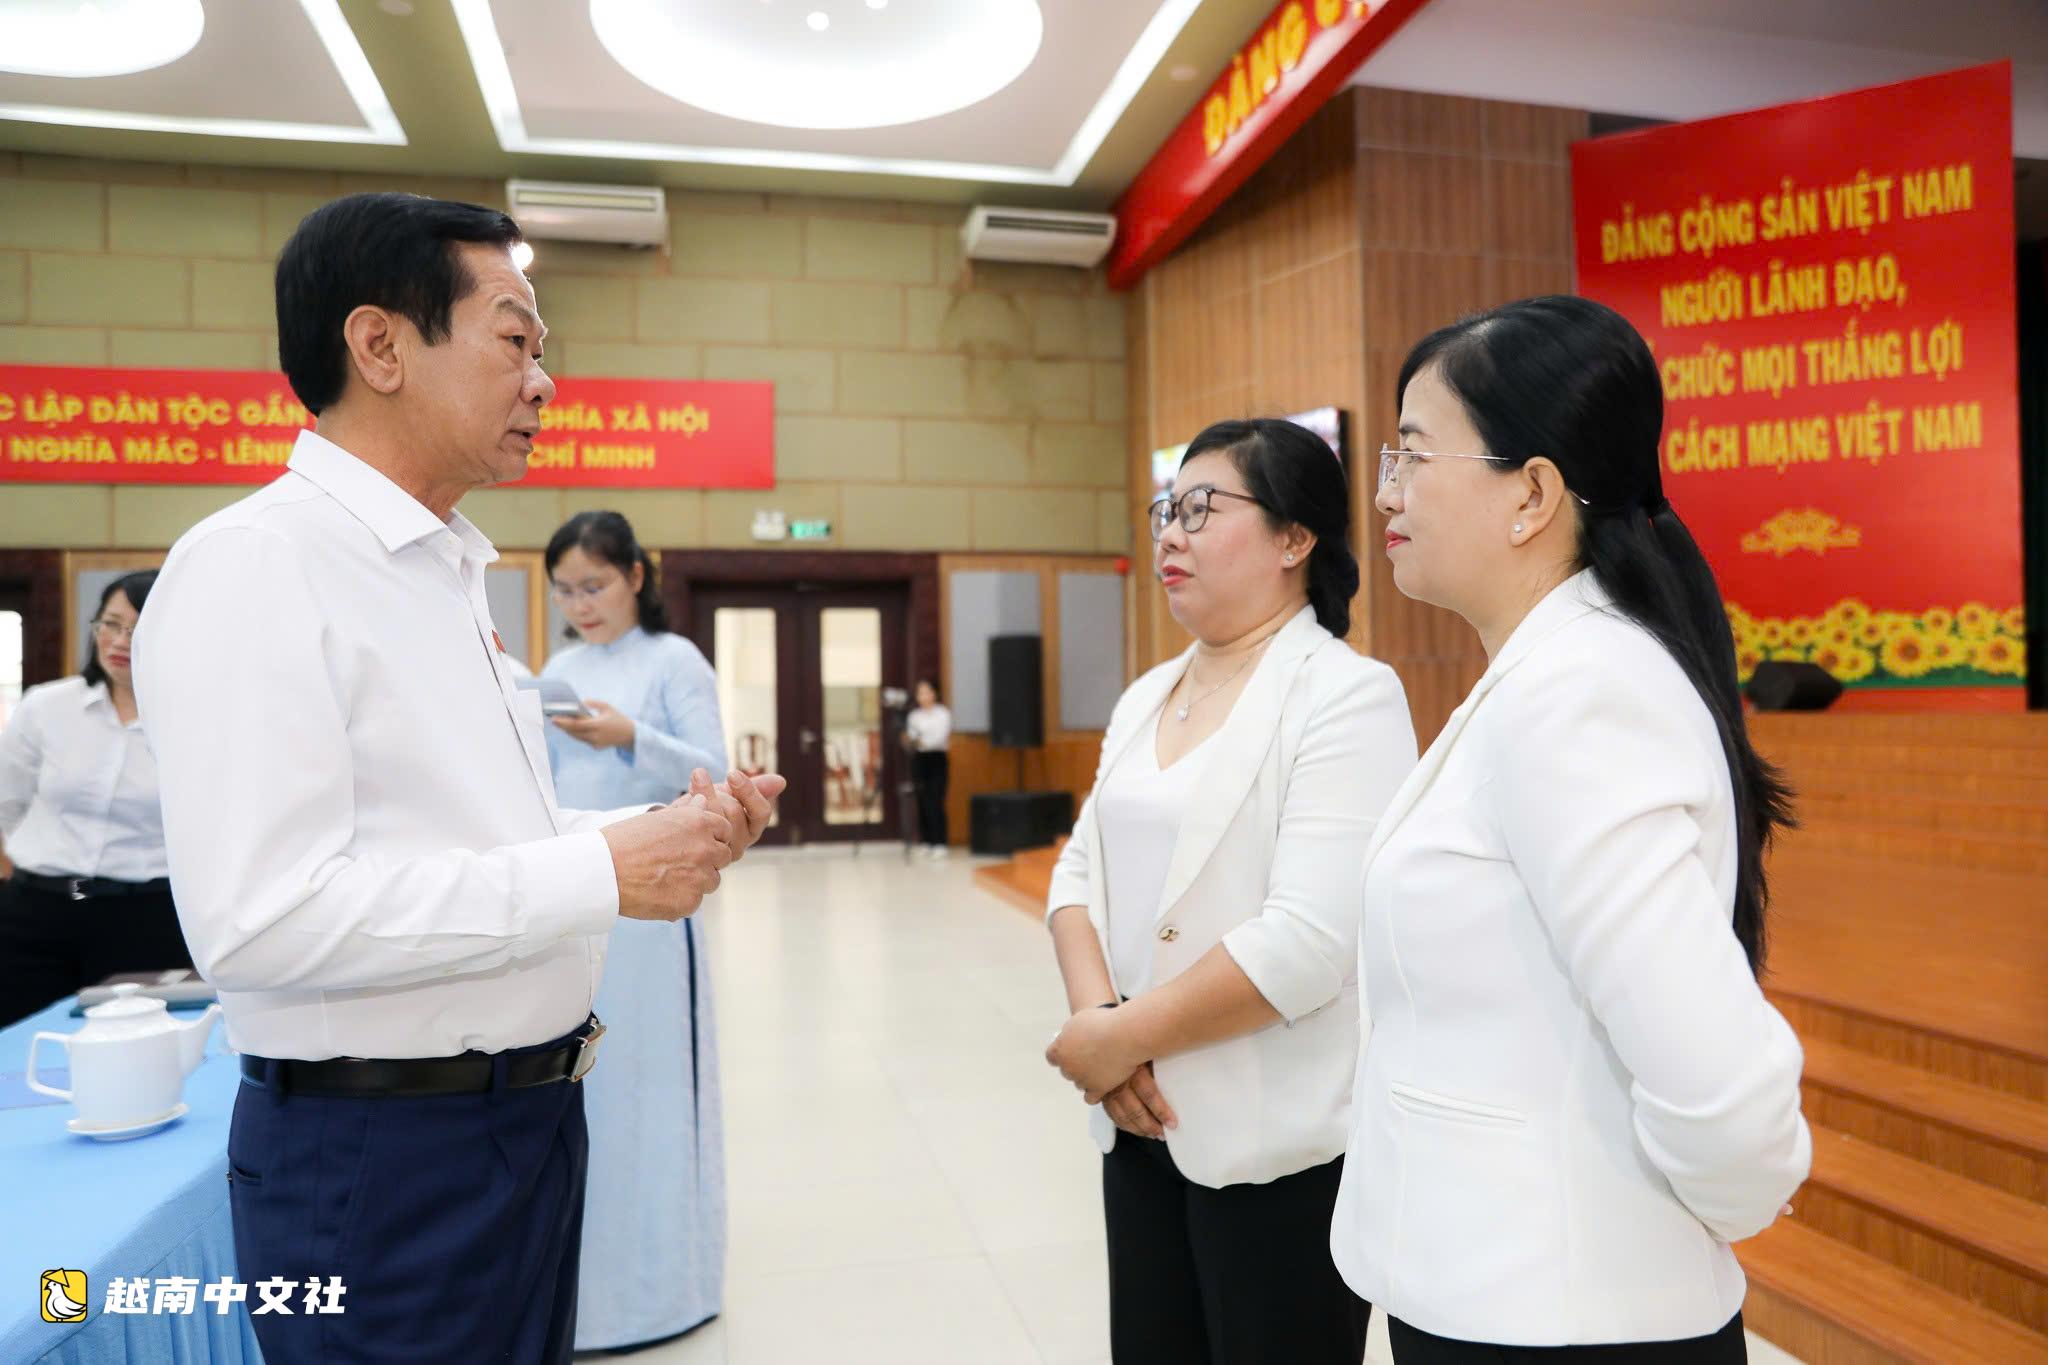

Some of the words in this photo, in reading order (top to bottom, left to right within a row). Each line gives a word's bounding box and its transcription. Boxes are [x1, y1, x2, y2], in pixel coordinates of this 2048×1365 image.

[1602, 201, 1674, 264] ĐẢNG
[1680, 194, 1756, 258] CỘNG
[1760, 176, 1820, 241] SẢN
[1825, 167, 1893, 236] VIỆT
[1902, 164, 1974, 219] NAM
[1661, 268, 1743, 327] NGƯỜI
[1834, 252, 1908, 312] ĐẠO,
[1663, 340, 1735, 401] CHỨC
[1742, 343, 1797, 399] MỌI
[1803, 316, 1904, 386] THẮNG
[1910, 317, 1964, 382] LỢI
[24, 389, 84, 428] LẬP
[91, 390, 158, 424] DÂN
[167, 394, 231, 430] TỘC
[239, 389, 307, 426] GẮN
[612, 400, 652, 432] XÃ
[657, 402, 709, 439] HỘI
[1666, 417, 1740, 473] CÁCH
[1748, 416, 1830, 474] MẠNG
[1836, 398, 1905, 466] VIỆT
[1913, 400, 1983, 453] NAM
[10, 431, 117, 463] NGHĨA
[124, 432, 198, 464] MÁC
[527, 438, 577, 468] CHÍ
[580, 444, 657, 469] MINH
